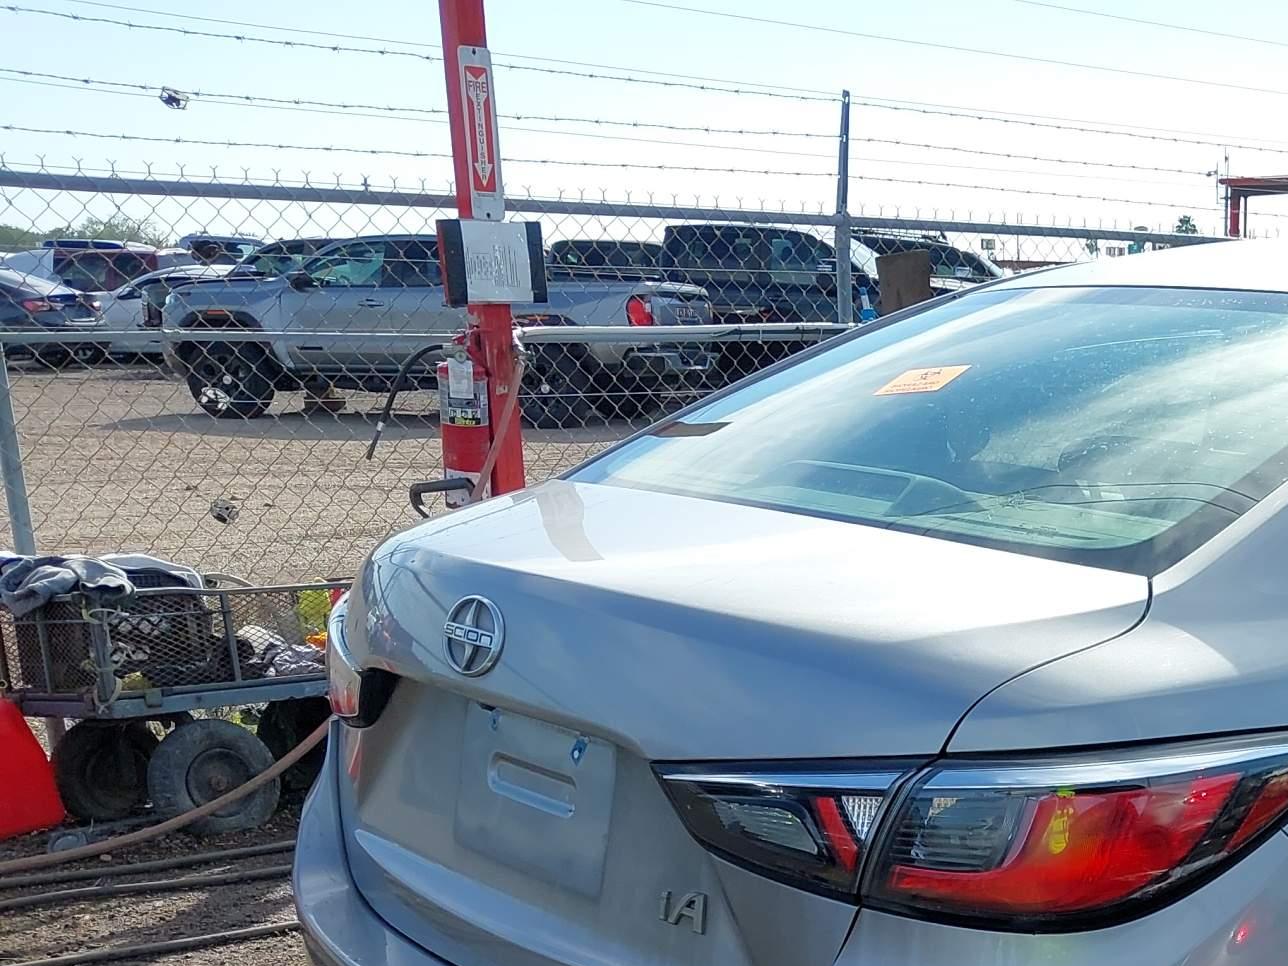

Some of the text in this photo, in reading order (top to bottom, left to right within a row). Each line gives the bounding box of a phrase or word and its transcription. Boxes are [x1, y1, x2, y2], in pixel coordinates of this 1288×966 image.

[468, 82, 487, 93] FIRE
[475, 93, 487, 180] EXTINGUISHER
[444, 623, 493, 647] SCION
